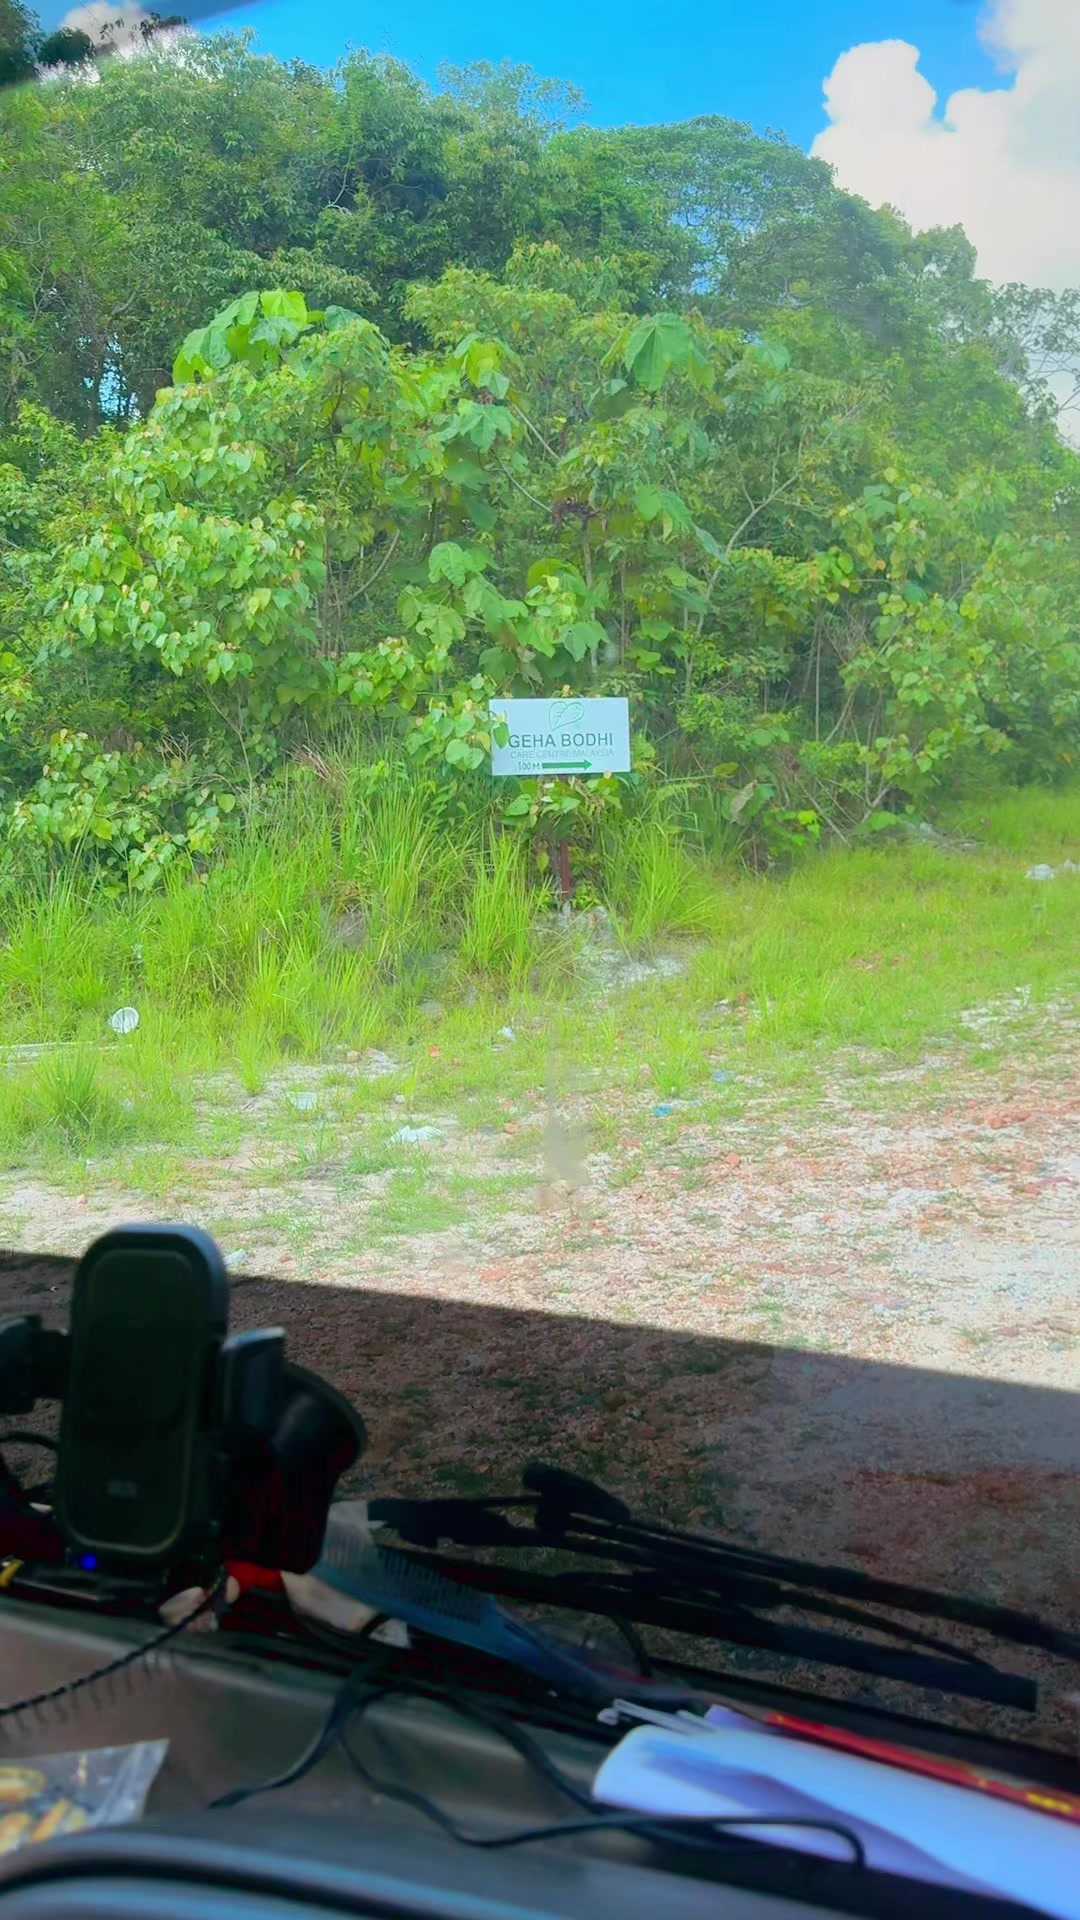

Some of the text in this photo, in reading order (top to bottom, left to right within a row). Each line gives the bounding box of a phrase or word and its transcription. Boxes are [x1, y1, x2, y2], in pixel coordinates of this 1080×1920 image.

[508, 733, 613, 748] GEHA BODHI
[510, 750, 534, 759] CARE
[573, 748, 614, 758] MALAYSIA
